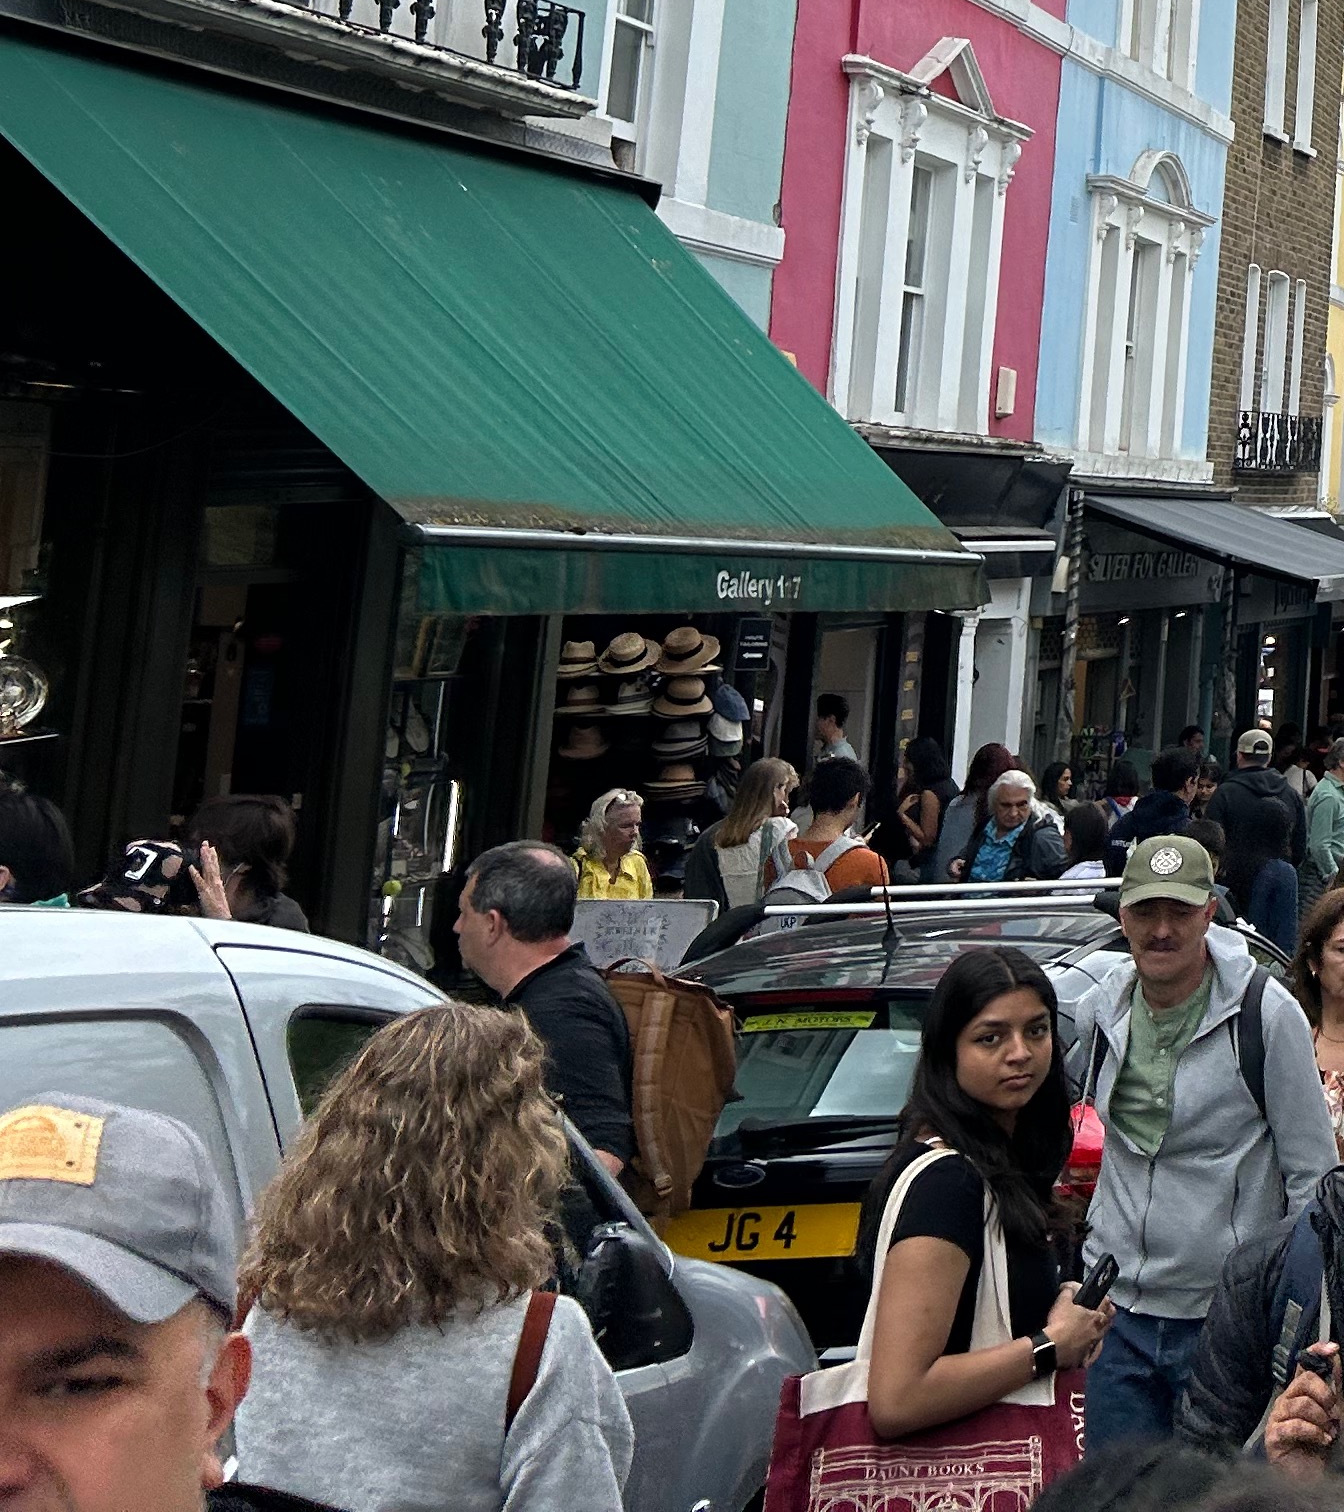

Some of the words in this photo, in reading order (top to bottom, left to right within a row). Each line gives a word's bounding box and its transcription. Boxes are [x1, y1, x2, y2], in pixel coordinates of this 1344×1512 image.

[1088, 553, 1131, 582] SILVER
[1132, 552, 1157, 580] FOX
[717, 570, 774, 605] Gallery
[708, 1212, 763, 1252] JG
[773, 1210, 797, 1249] 4
[864, 1465, 921, 1481] DAUNT
[928, 1462, 985, 1477] BOOKS
